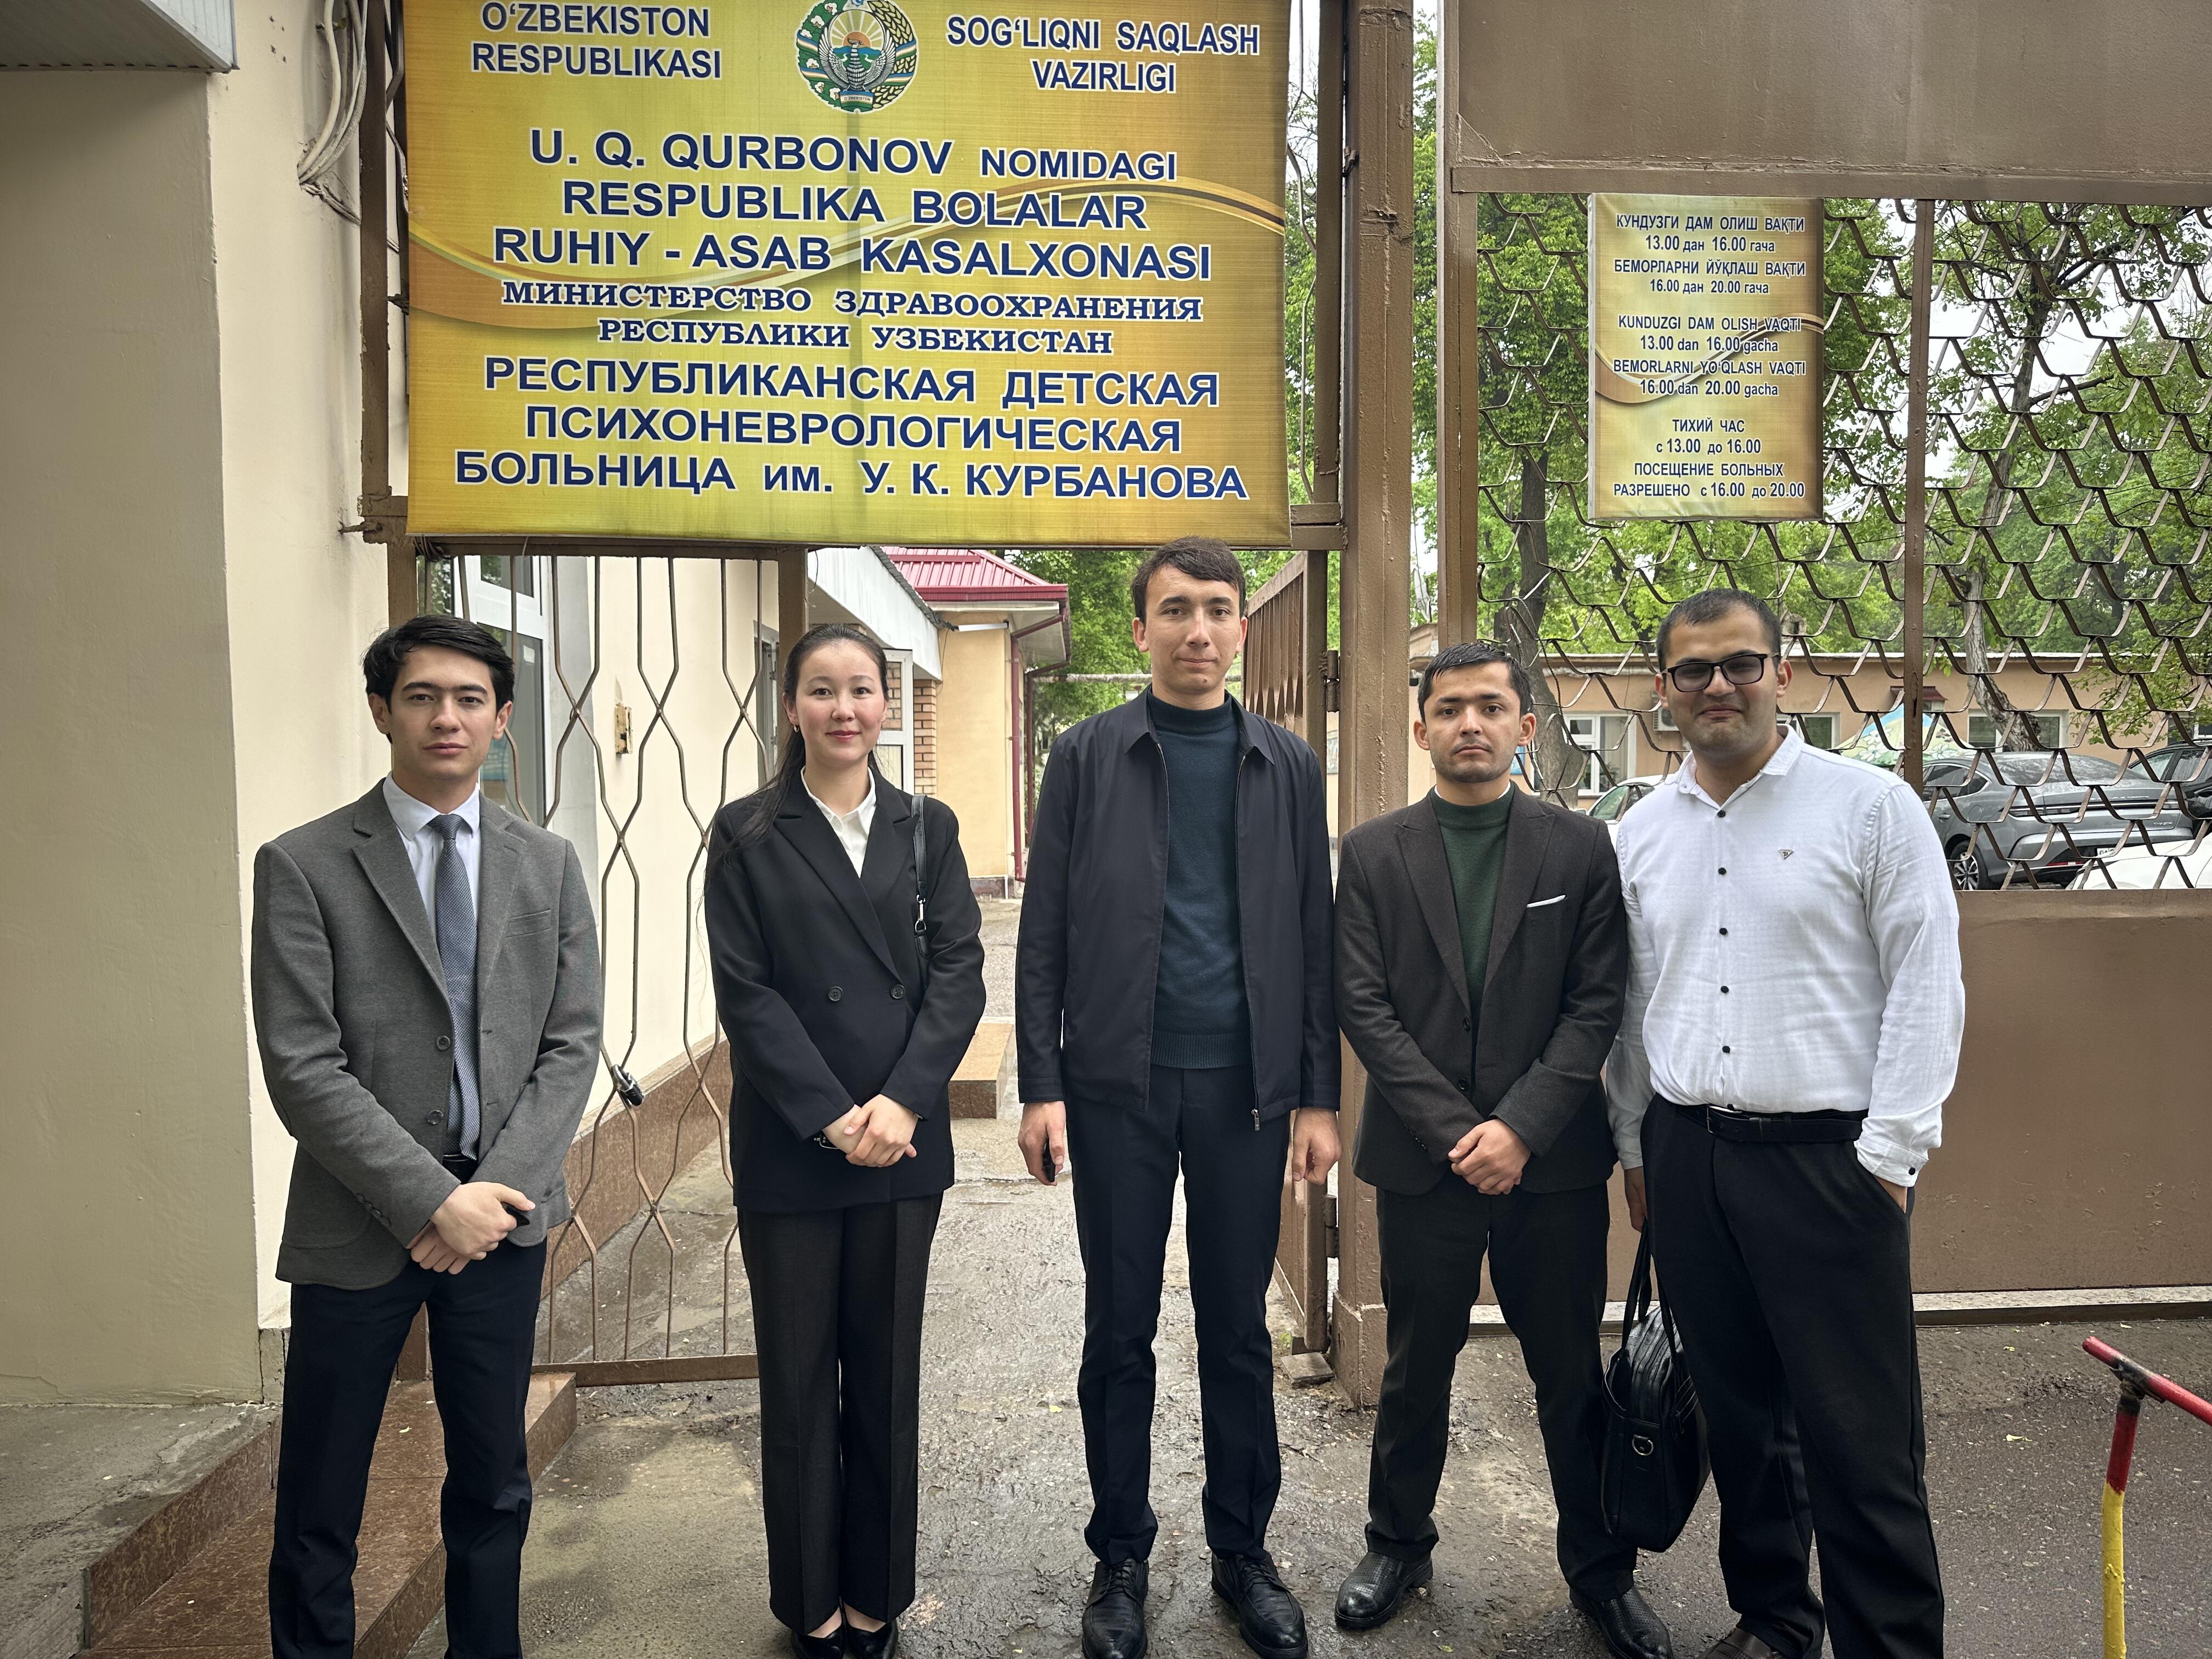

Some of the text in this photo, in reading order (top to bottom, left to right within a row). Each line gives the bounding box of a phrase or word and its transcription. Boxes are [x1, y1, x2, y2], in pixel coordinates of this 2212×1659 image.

[1118, 22, 1257, 53] SAQLASH
[473, 43, 720, 78] RESPUBLIKASI
[1033, 61, 1174, 92] VAZIRLIGI
[532, 130, 1175, 180] U. Q. QURBONOV NOMIDAGI
[565, 181, 1146, 229] RESPUBLIKA BOLALAR
[1617, 214, 1804, 234] КУНДУЗГИ ДАМ ОЛИШ ВАҚТИ
[495, 228, 648, 266] RUHIY
[693, 235, 831, 270] ASAB
[863, 239, 1209, 279] KASALXONASI
[1646, 235, 1775, 253] 13.00 дан 16.00 гача
[1615, 258, 1805, 279] БЕМОРЛАРНИ ЙЎҚЛАШ ВАҚТИ
[1650, 279, 1769, 295] 16.00 дан 20.00 гача
[505, 282, 1200, 320] МИНИСТЕРСТВО ЗДРАВООХРАНЕНИЯ
[1618, 315, 1801, 332] KUNDUZGI DAM OLISH VAQTI
[601, 319, 1111, 353] РЕСПУБЛИКИ УЗБЕКИСТАН
[1640, 336, 1778, 354] 13.00 dan 16.00 gacha
[1613, 359, 1694, 374] BEMORLARNI
[1769, 361, 1805, 376] VAQTI
[487, 358, 1217, 409] РЕСПУБЛИКАНСКАЯ ДЕТСКАЯ
[1640, 380, 1778, 397] 16.00 dan 20.00 gacha
[527, 405, 1182, 452] ПСИХОНЕВРОЛОГИЧЕСКАЯ
[1673, 417, 1745, 432] ТИХИЙ ЧАС
[1667, 439, 1700, 453] 13.00
[1707, 443, 1723, 455] до
[1727, 439, 1761, 454] 16.00
[458, 452, 735, 495] БОЛЬНИЦА
[861, 462, 894, 493] У.
[913, 463, 949, 494] К.
[967, 465, 1246, 498] КУРБАНОВА
[1634, 463, 1784, 478] ПОСЕЩЕНИЕ БОЛЬНЫХ
[1614, 483, 1690, 496] РАЗРЕШЕНО
[1711, 483, 1745, 497] 16.00
[1752, 486, 1767, 498] до
[1770, 483, 1804, 498] 20.00
